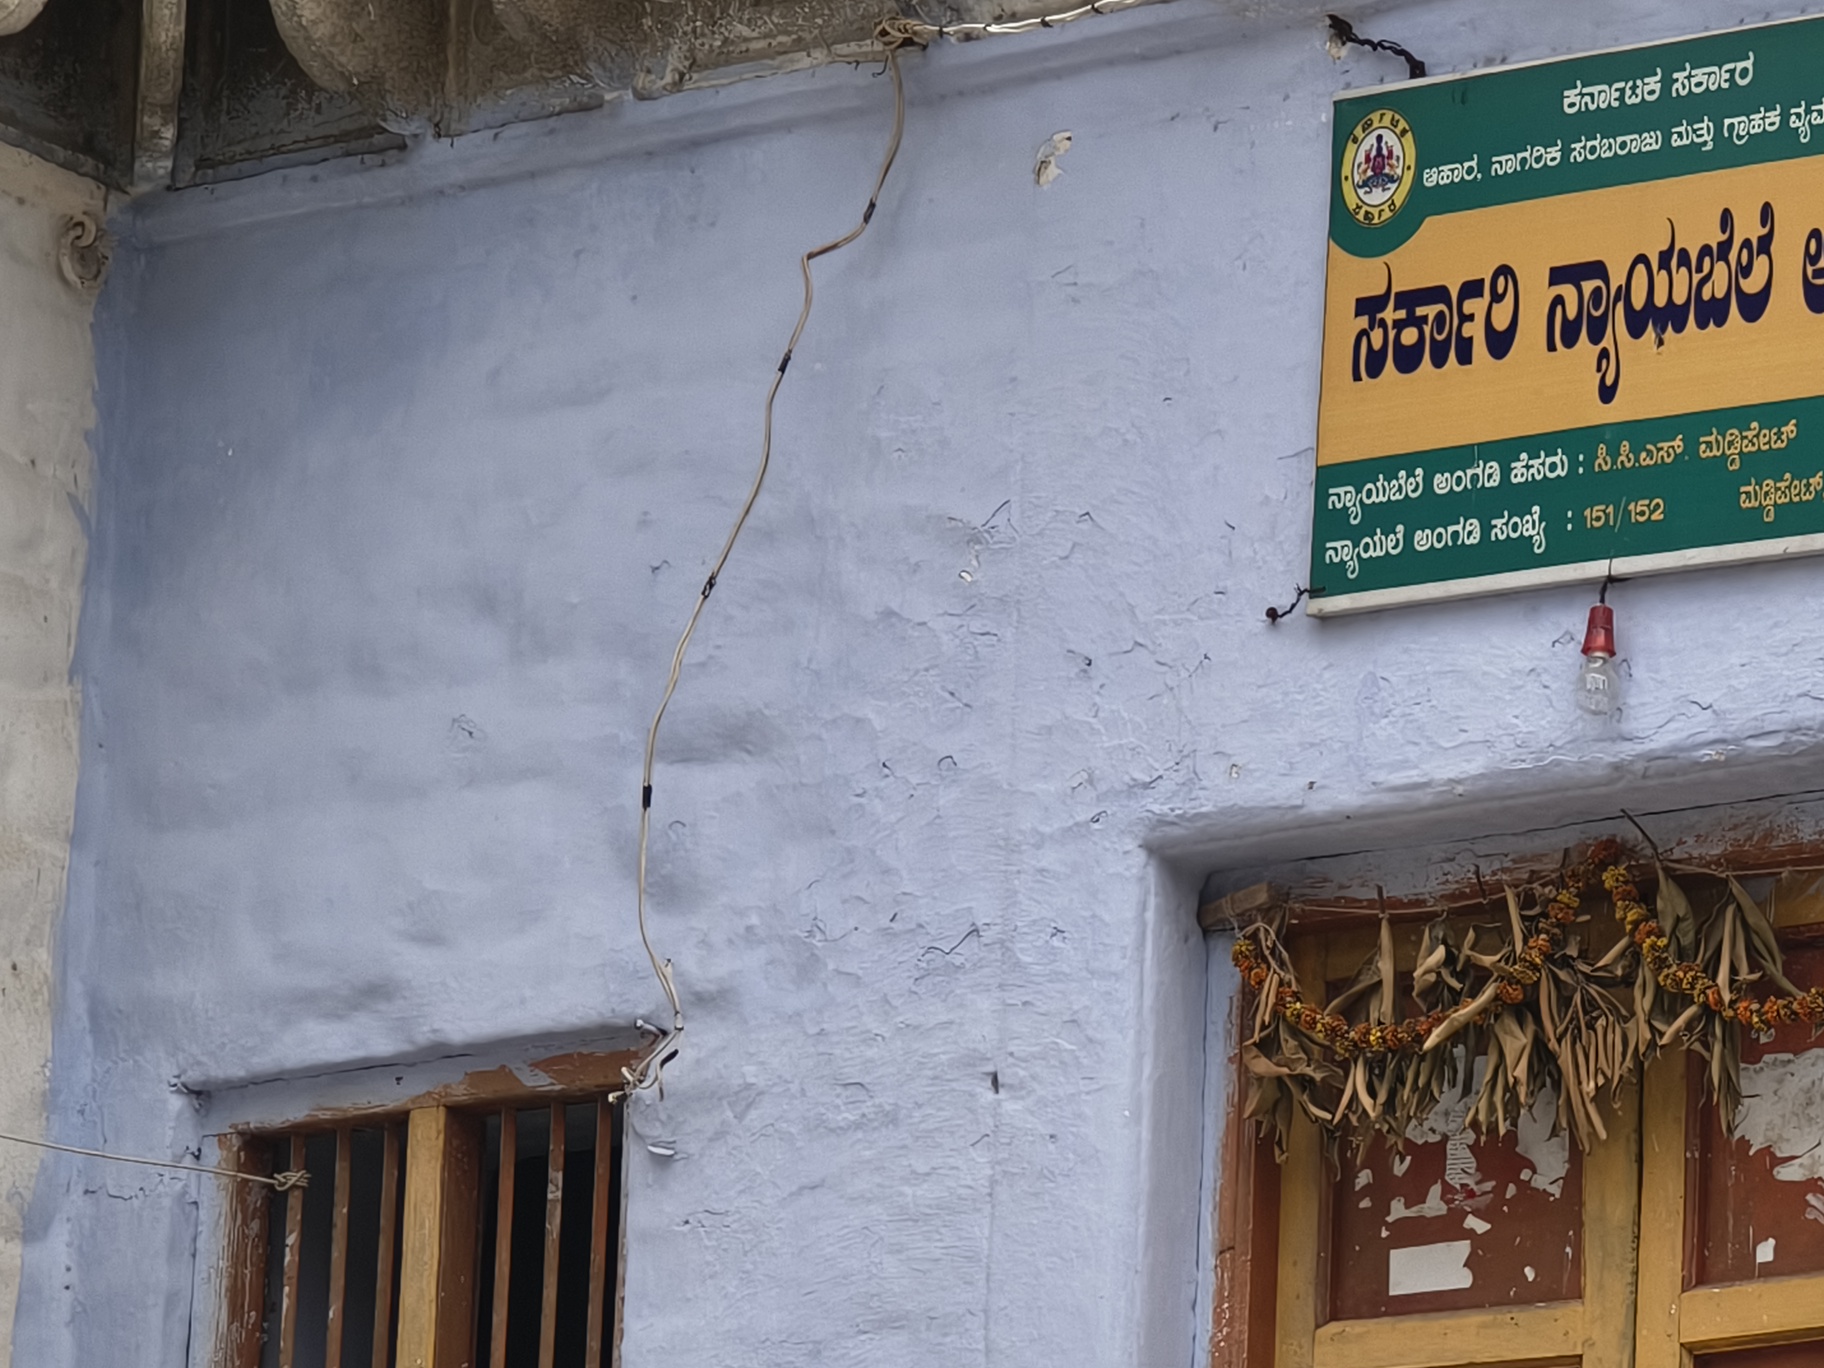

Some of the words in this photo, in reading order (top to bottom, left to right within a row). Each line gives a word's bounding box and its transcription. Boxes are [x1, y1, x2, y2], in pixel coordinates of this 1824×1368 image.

[1563, 67, 1662, 114] ಕರ್ನಾಟಕ
[1671, 50, 1754, 97] ಸರ್ಕಾರ
[1491, 140, 1562, 177] ನಾಗರಿಕ
[1570, 129, 1662, 163] ಸರಬರಾಜು
[1671, 116, 1714, 151] ಮತ್ತು
[1723, 104, 1781, 145] ಗ್ರಾಹಕ
[1351, 260, 1519, 382] ಸರ್ಕಾರಿ
[1547, 201, 1775, 405] ನ್ಯಾಯಬೆಲೆ
[1328, 467, 1424, 524] ನ್ಯಾಯಬೆಲೆ
[1433, 459, 1500, 494] ಅಂಗಡಿ
[1510, 448, 1568, 483] ಹೆಸರು
[1325, 524, 1404, 579] ನ್ಯಾಯಲೆ
[1414, 516, 1481, 551] ಅಂಗಡಿ
[1490, 505, 1546, 553] ಸಂಖ್ಯೆ
[1583, 496, 1664, 533] 151/152
